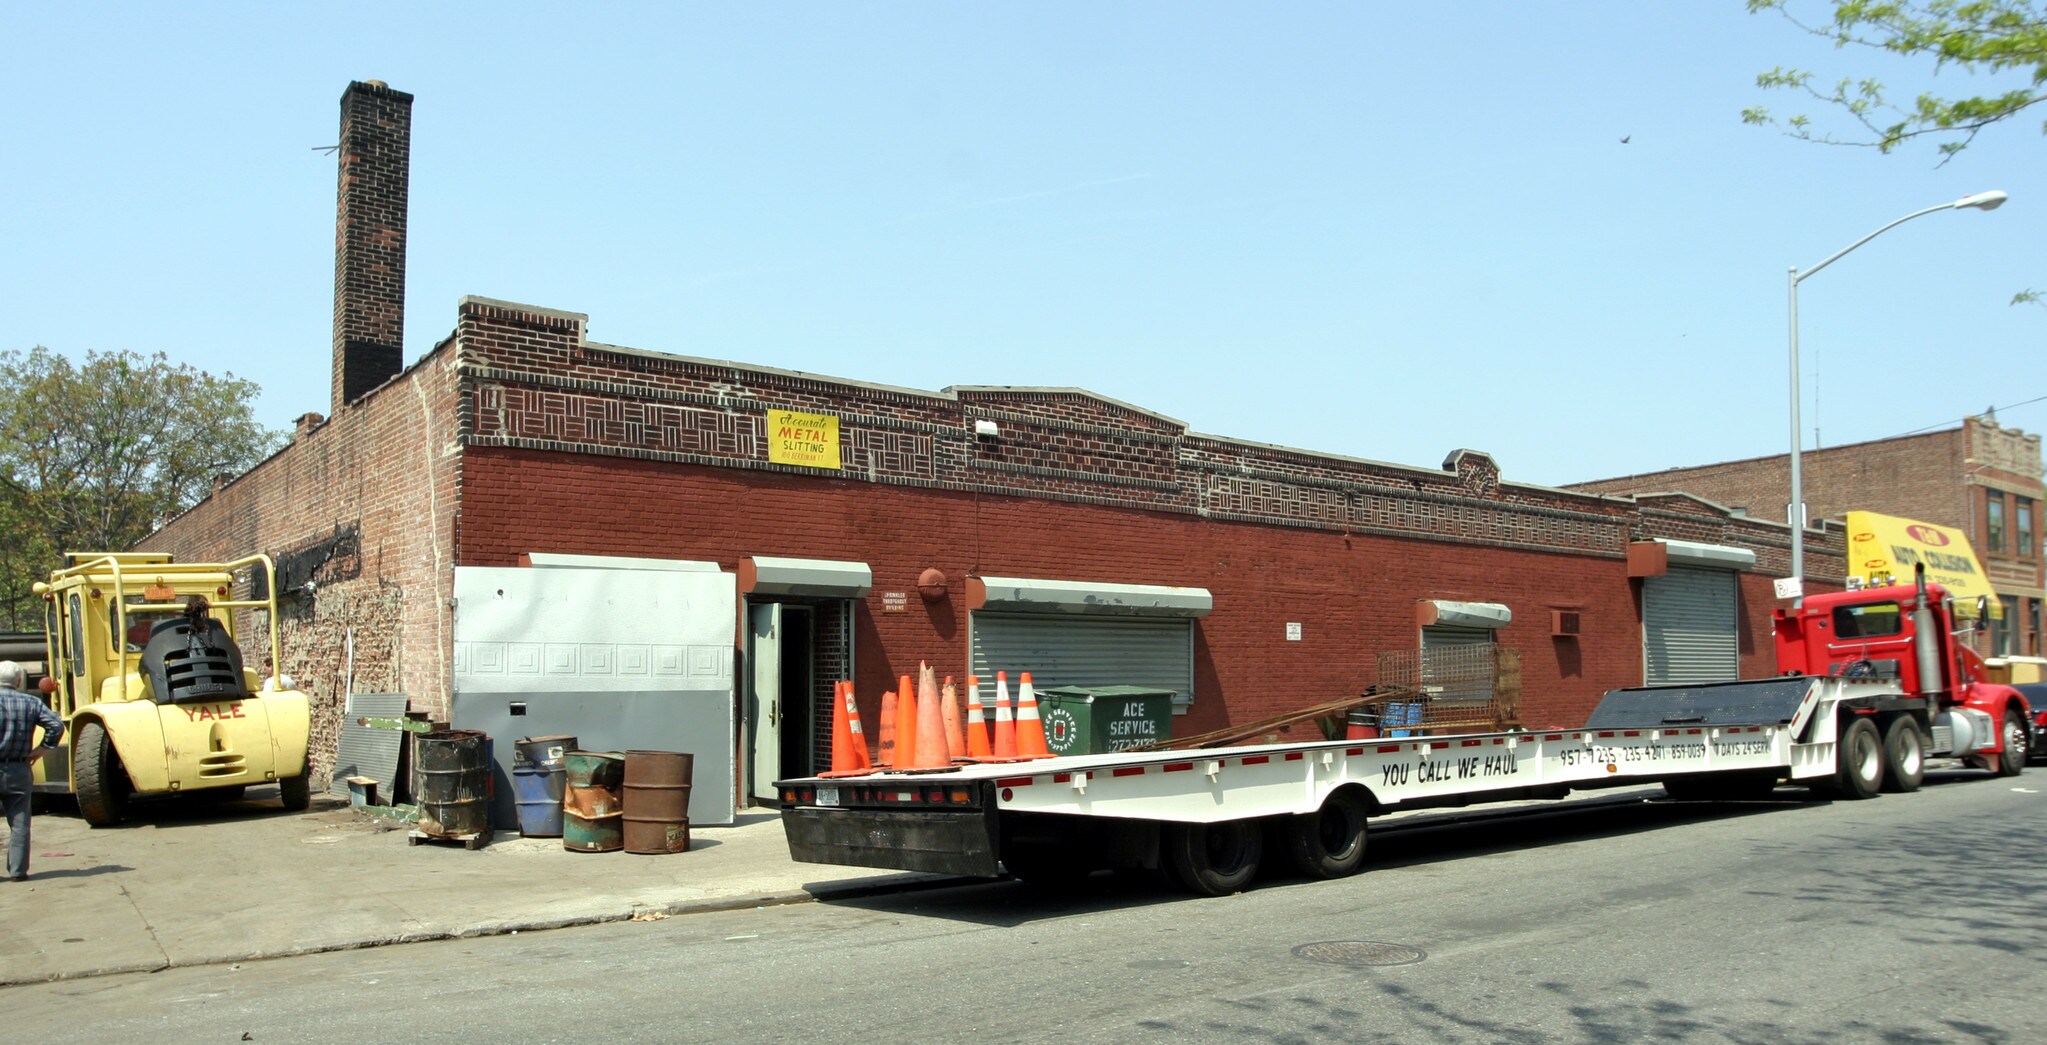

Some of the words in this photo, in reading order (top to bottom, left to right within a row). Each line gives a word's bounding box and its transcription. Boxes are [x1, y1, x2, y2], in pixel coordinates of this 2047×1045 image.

[780, 414, 827, 429] Accurate
[778, 426, 828, 442] METAL
[783, 440, 825, 453] SLITTING
[1891, 545, 1921, 566] AUTO
[1923, 550, 1976, 574] COLLISION
[182, 702, 245, 722] YALE
[1123, 702, 1144, 717] ACE
[1053, 708, 1077, 733] SERVICE
[1110, 720, 1155, 736] SERVICE
[1382, 763, 1409, 787] YOU
[1418, 760, 1451, 783] CALL
[1458, 757, 1479, 779] WE
[1484, 754, 1518, 776] HAUL
[1622, 745, 1665, 762] 235-4271
[1671, 743, 1706, 759] 859-0039
[1721, 743, 1740, 756] DAYS
